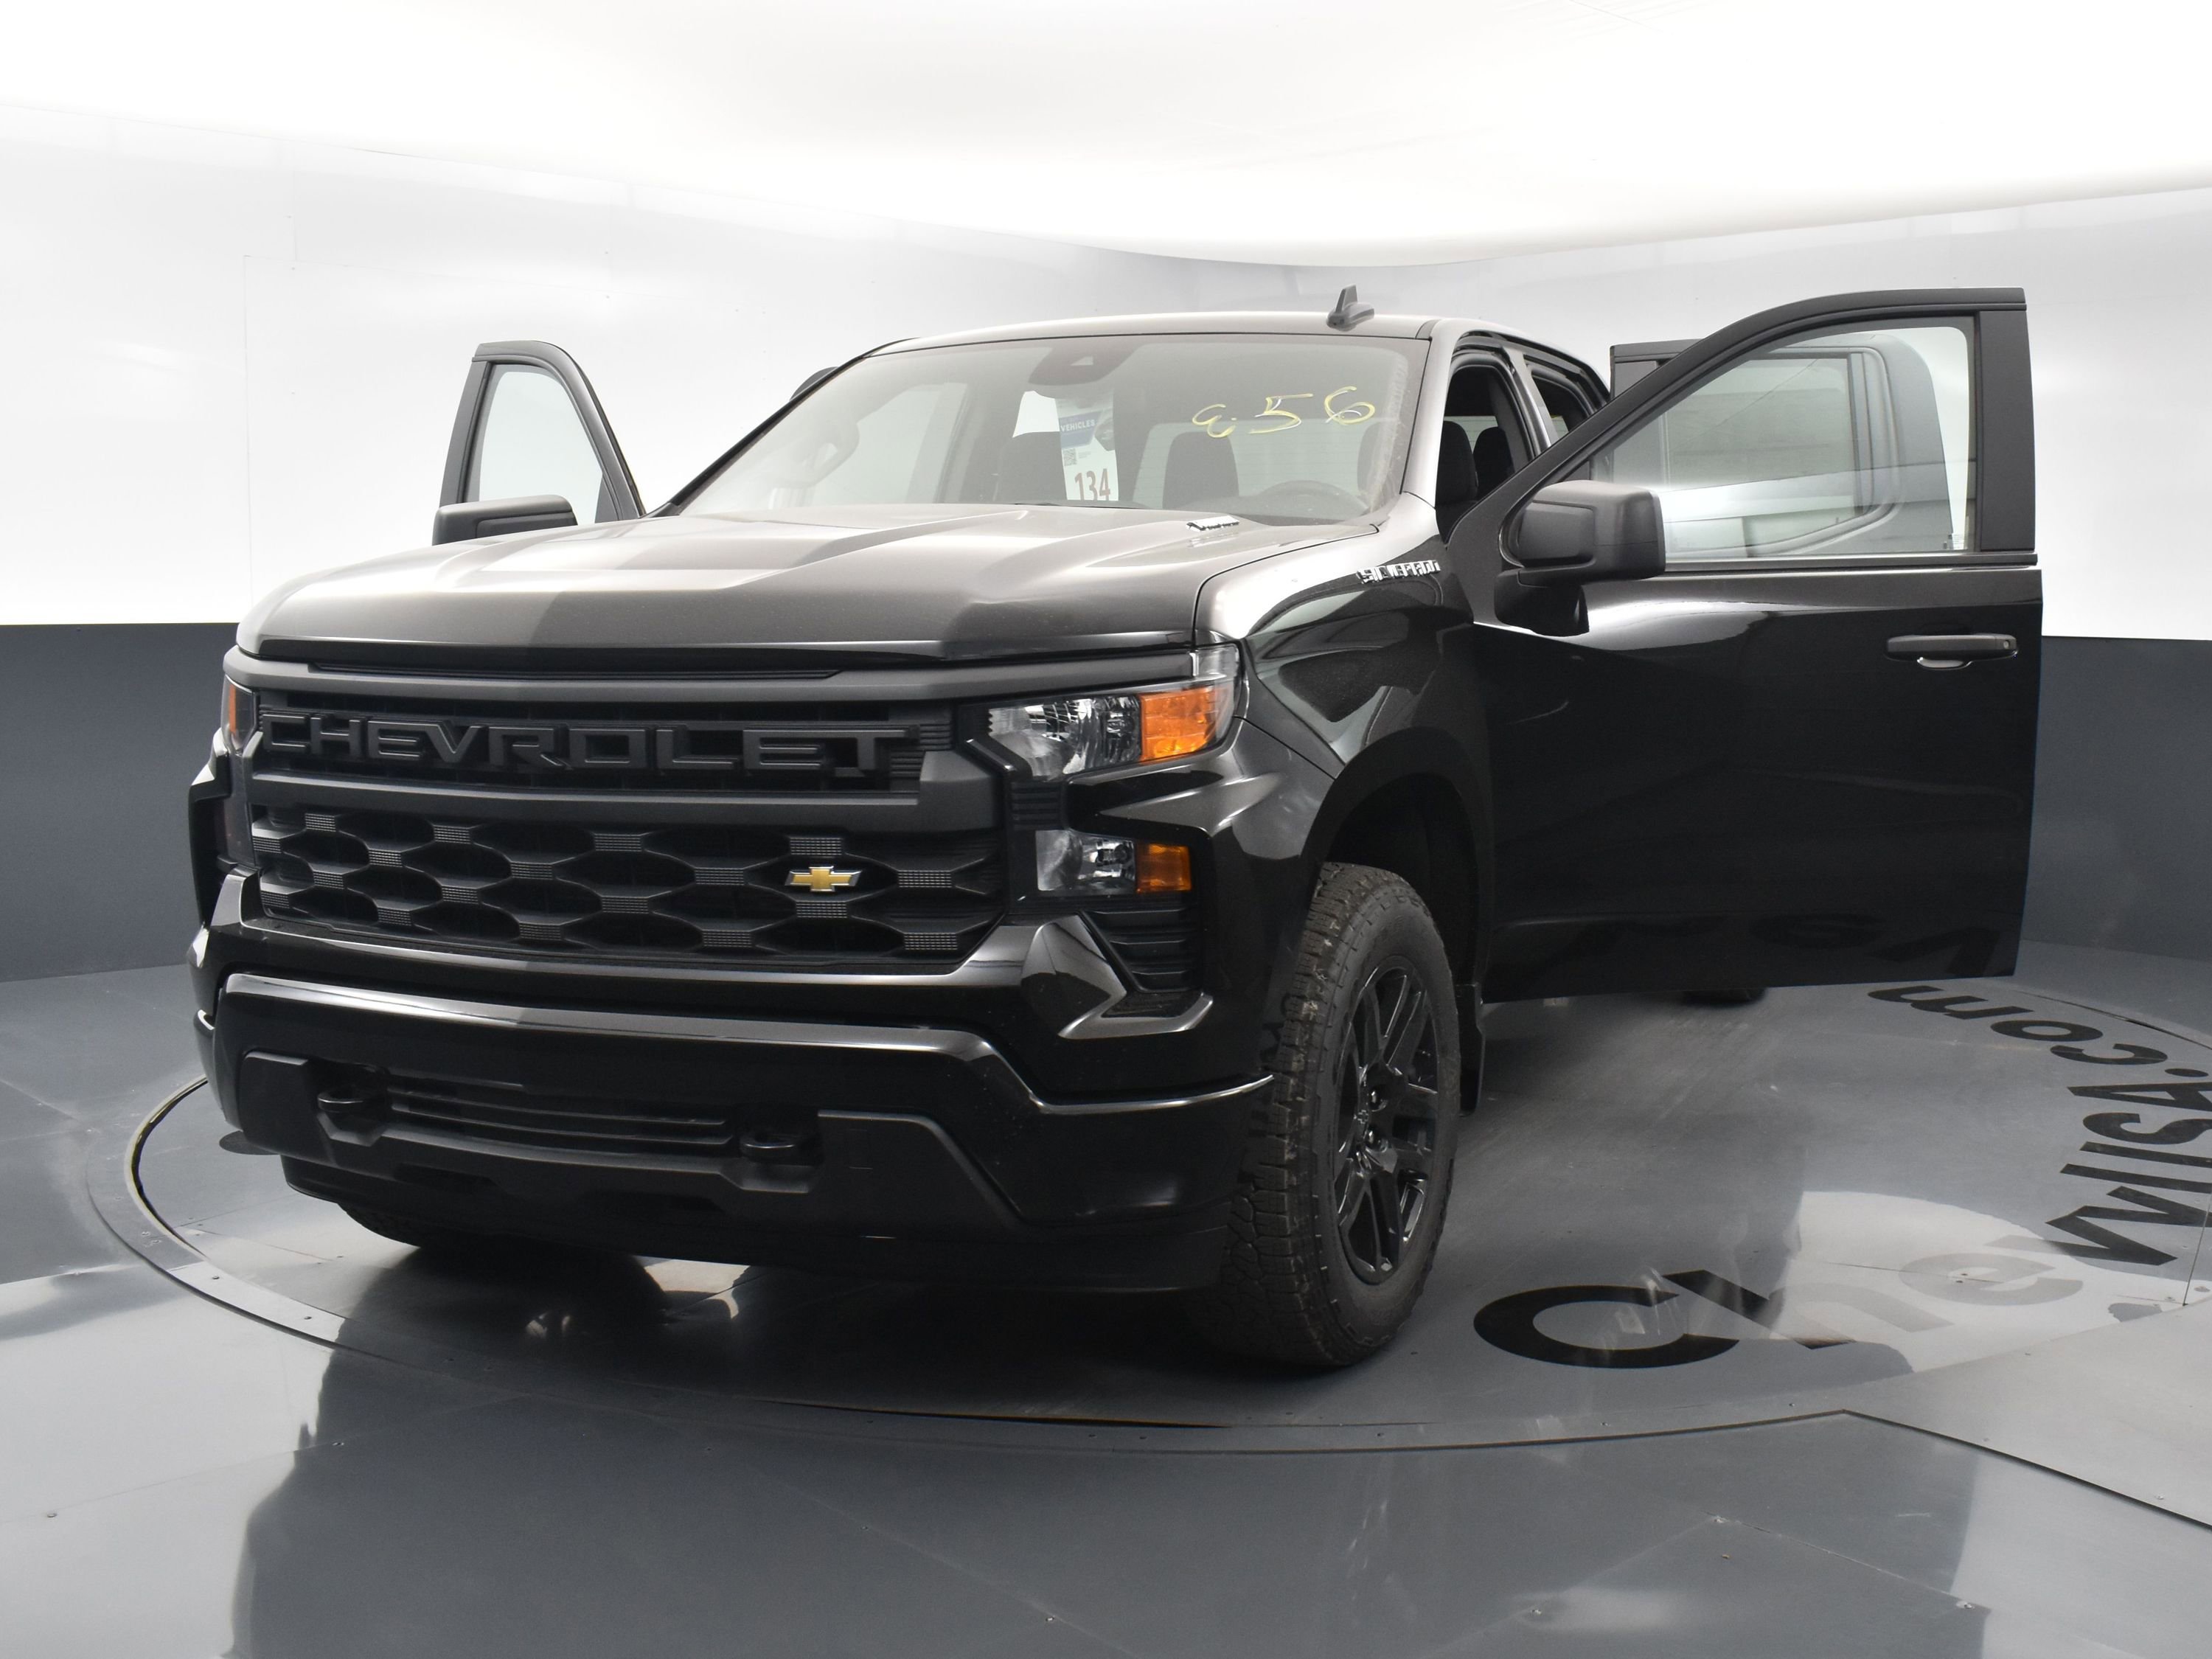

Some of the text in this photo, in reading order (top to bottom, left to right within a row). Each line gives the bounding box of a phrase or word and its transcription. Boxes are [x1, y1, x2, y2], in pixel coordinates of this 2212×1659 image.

[1060, 419, 1096, 433] VEHICLES
[1074, 467, 1111, 501] 134
[262, 712, 919, 777] CHEVROLET
